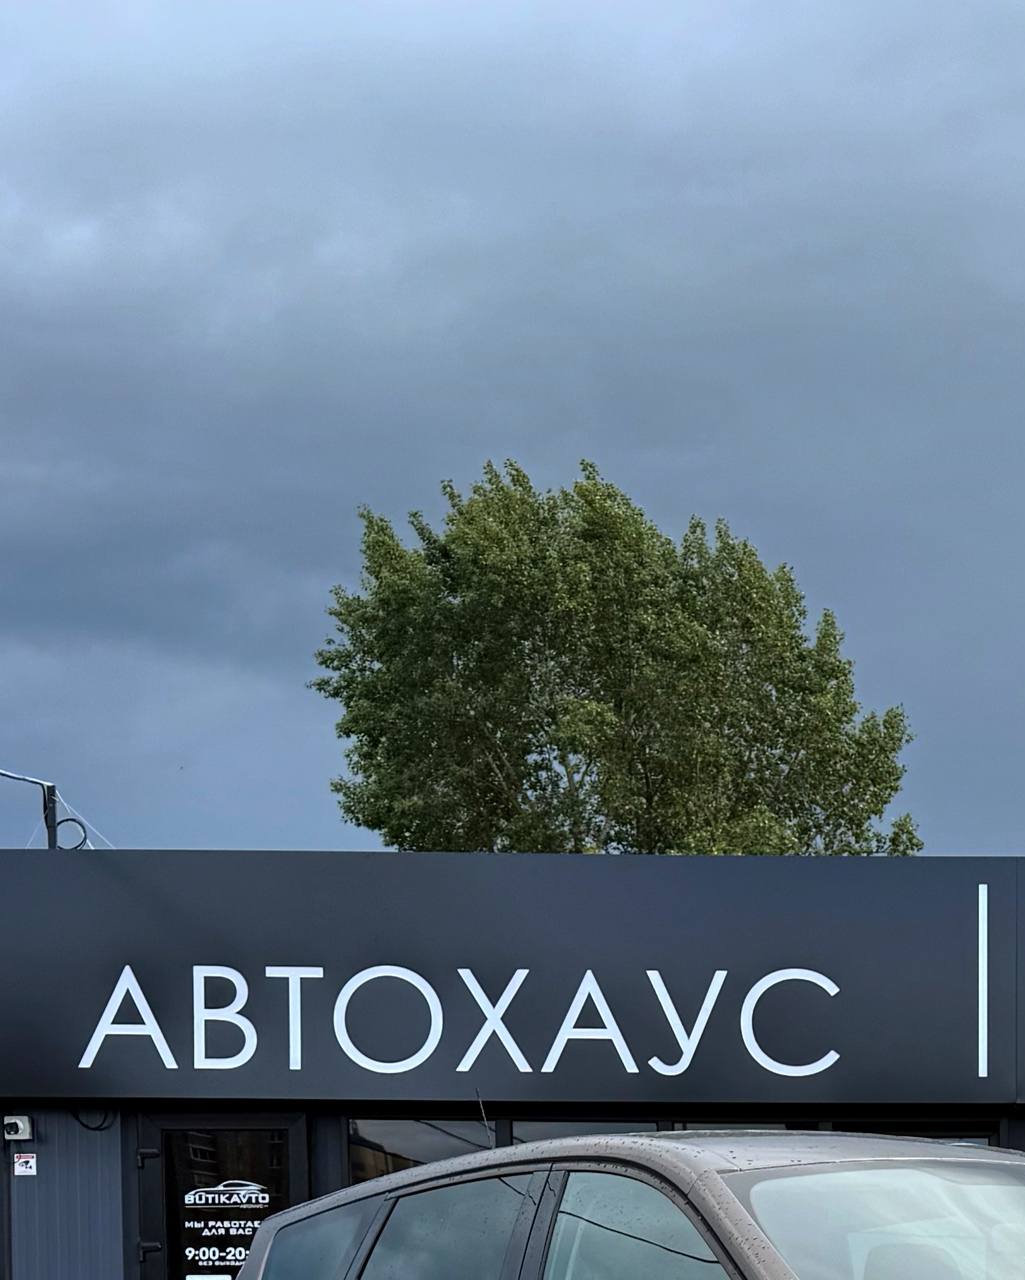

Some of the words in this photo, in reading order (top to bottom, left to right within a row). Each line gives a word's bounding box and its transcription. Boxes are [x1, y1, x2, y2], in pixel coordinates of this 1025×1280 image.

[78, 964, 842, 1078] АВТОХАУС
[184, 1193, 270, 1204] BUTIKAVTO
[184, 1220, 204, 1228] МЫ
[208, 1220, 262, 1228] РАБОТАЕ
[202, 1228, 225, 1236] ДЛЯ
[229, 1227, 253, 1235] ВАС
[184, 1247, 250, 1260] 9:00-20:
